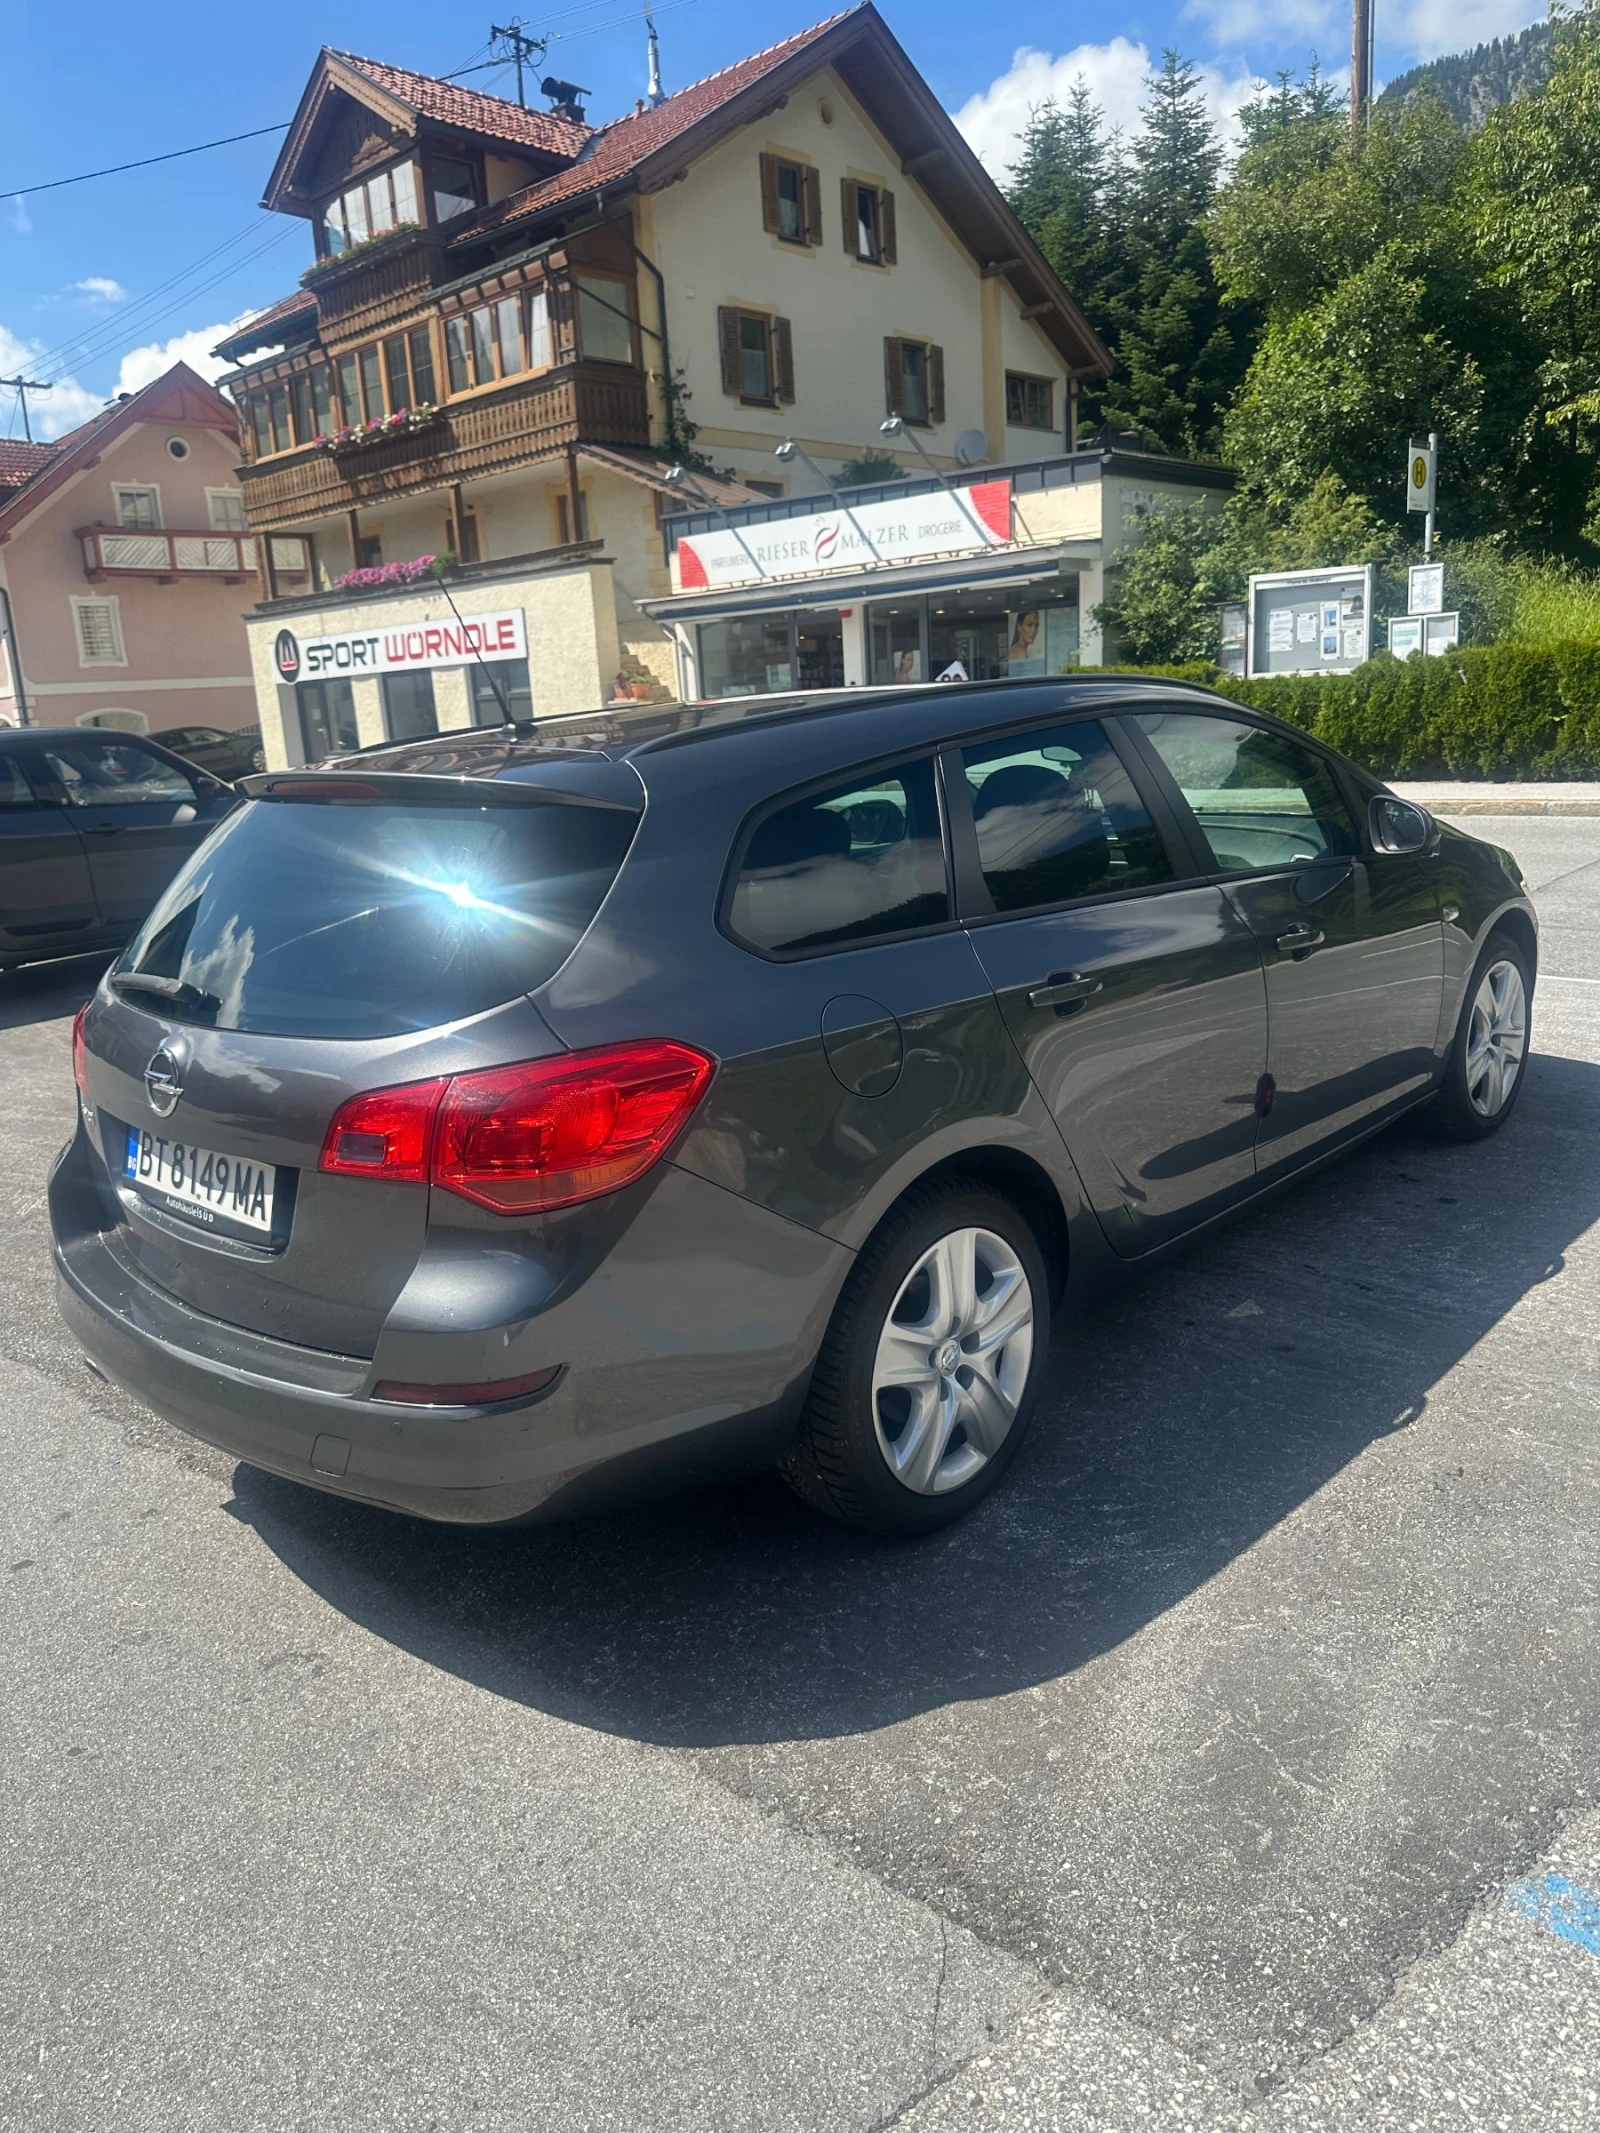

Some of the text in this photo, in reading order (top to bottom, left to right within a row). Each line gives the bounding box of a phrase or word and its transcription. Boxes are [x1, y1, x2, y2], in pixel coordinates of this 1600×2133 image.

[757, 540, 810, 562] RIESER
[841, 525, 909, 550] MALZER
[918, 520, 963, 539] DROGERIE
[306, 618, 516, 672] SPORT WÖRNDLE
[127, 1155, 137, 1171] BG
